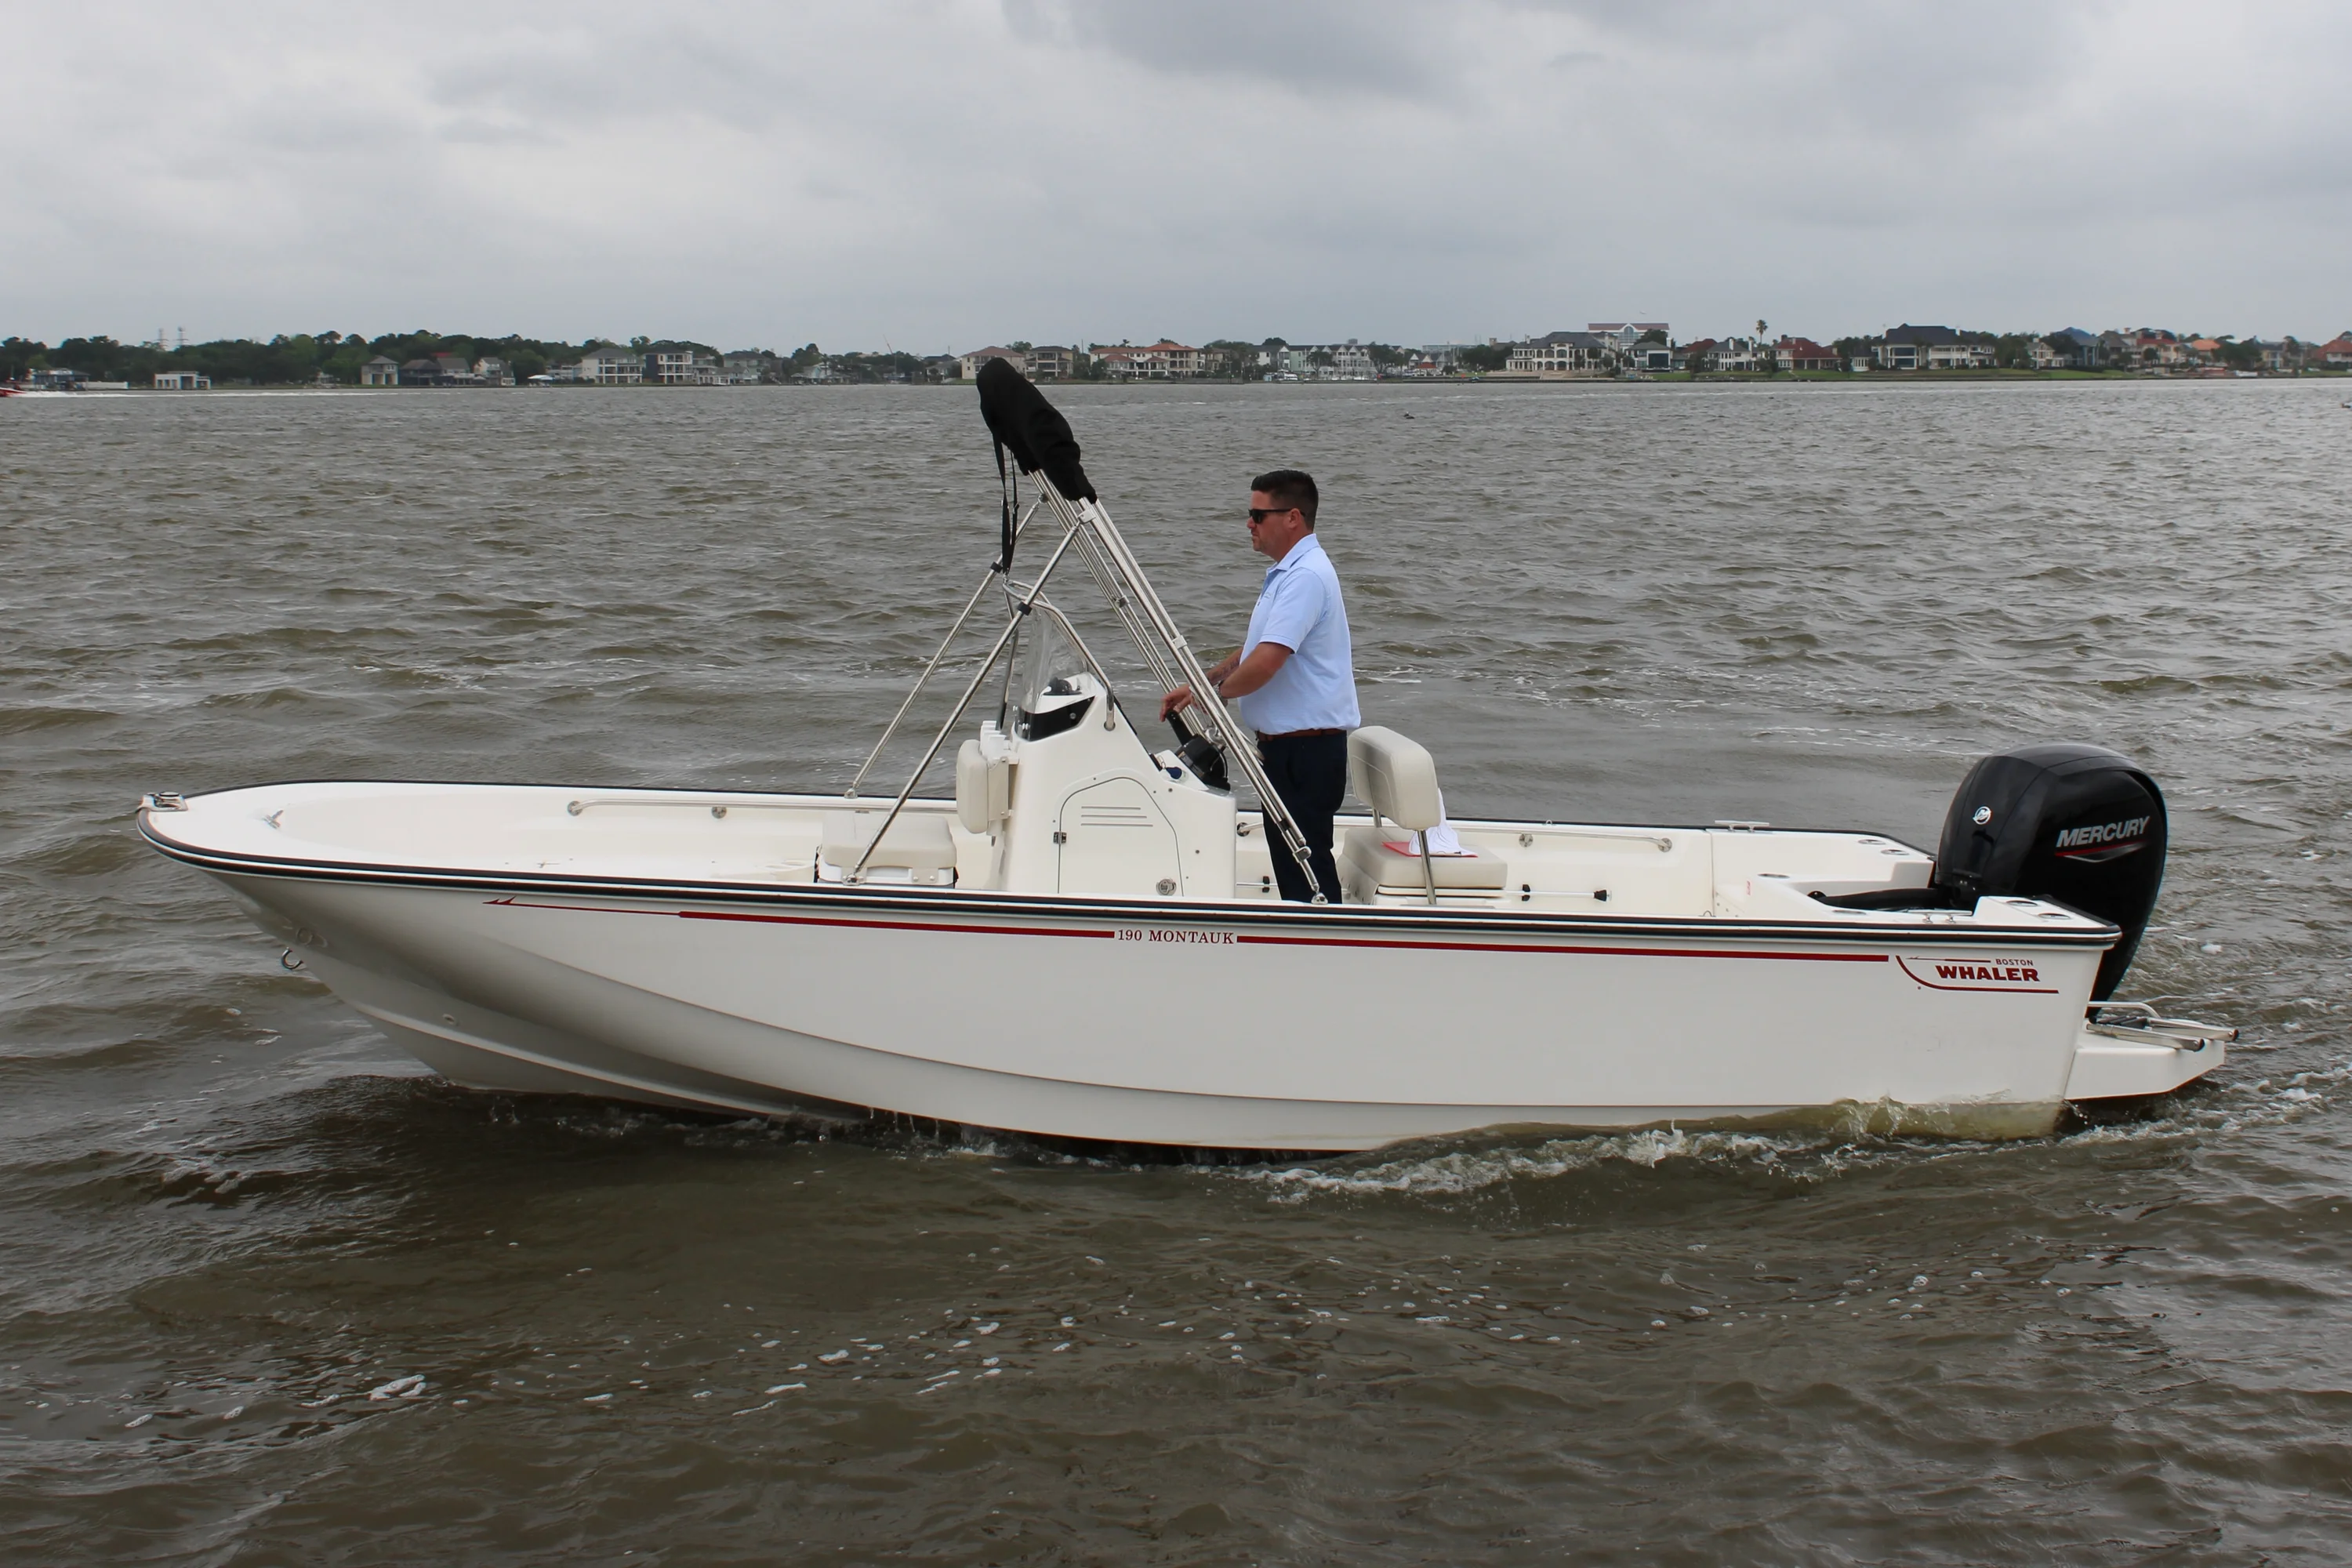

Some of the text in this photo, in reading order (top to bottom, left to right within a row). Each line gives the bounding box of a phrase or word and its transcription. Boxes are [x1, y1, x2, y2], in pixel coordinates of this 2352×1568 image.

[2056, 815, 2150, 848] MERCURY
[1118, 929, 1234, 944] 190 MONTAUK
[1936, 965, 2040, 982] WHALER
